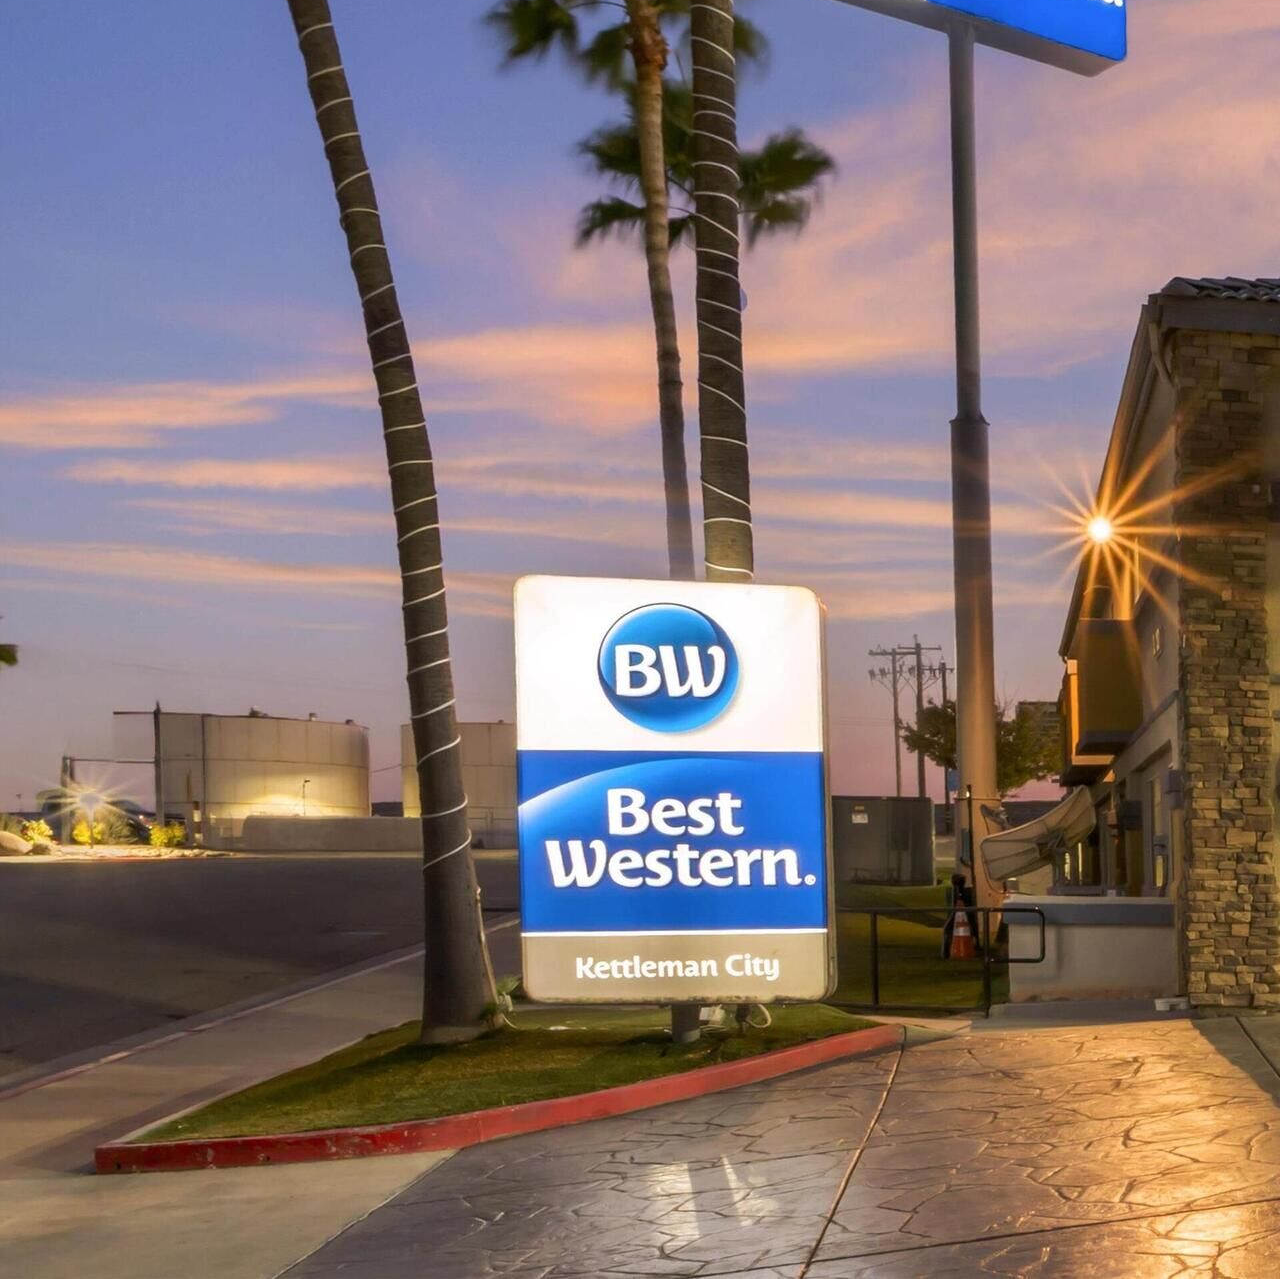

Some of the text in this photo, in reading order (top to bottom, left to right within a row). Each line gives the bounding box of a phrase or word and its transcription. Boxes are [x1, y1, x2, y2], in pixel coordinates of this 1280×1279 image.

[614, 644, 727, 698] BW
[607, 788, 744, 836] Best
[575, 953, 780, 982] Kettleman City
